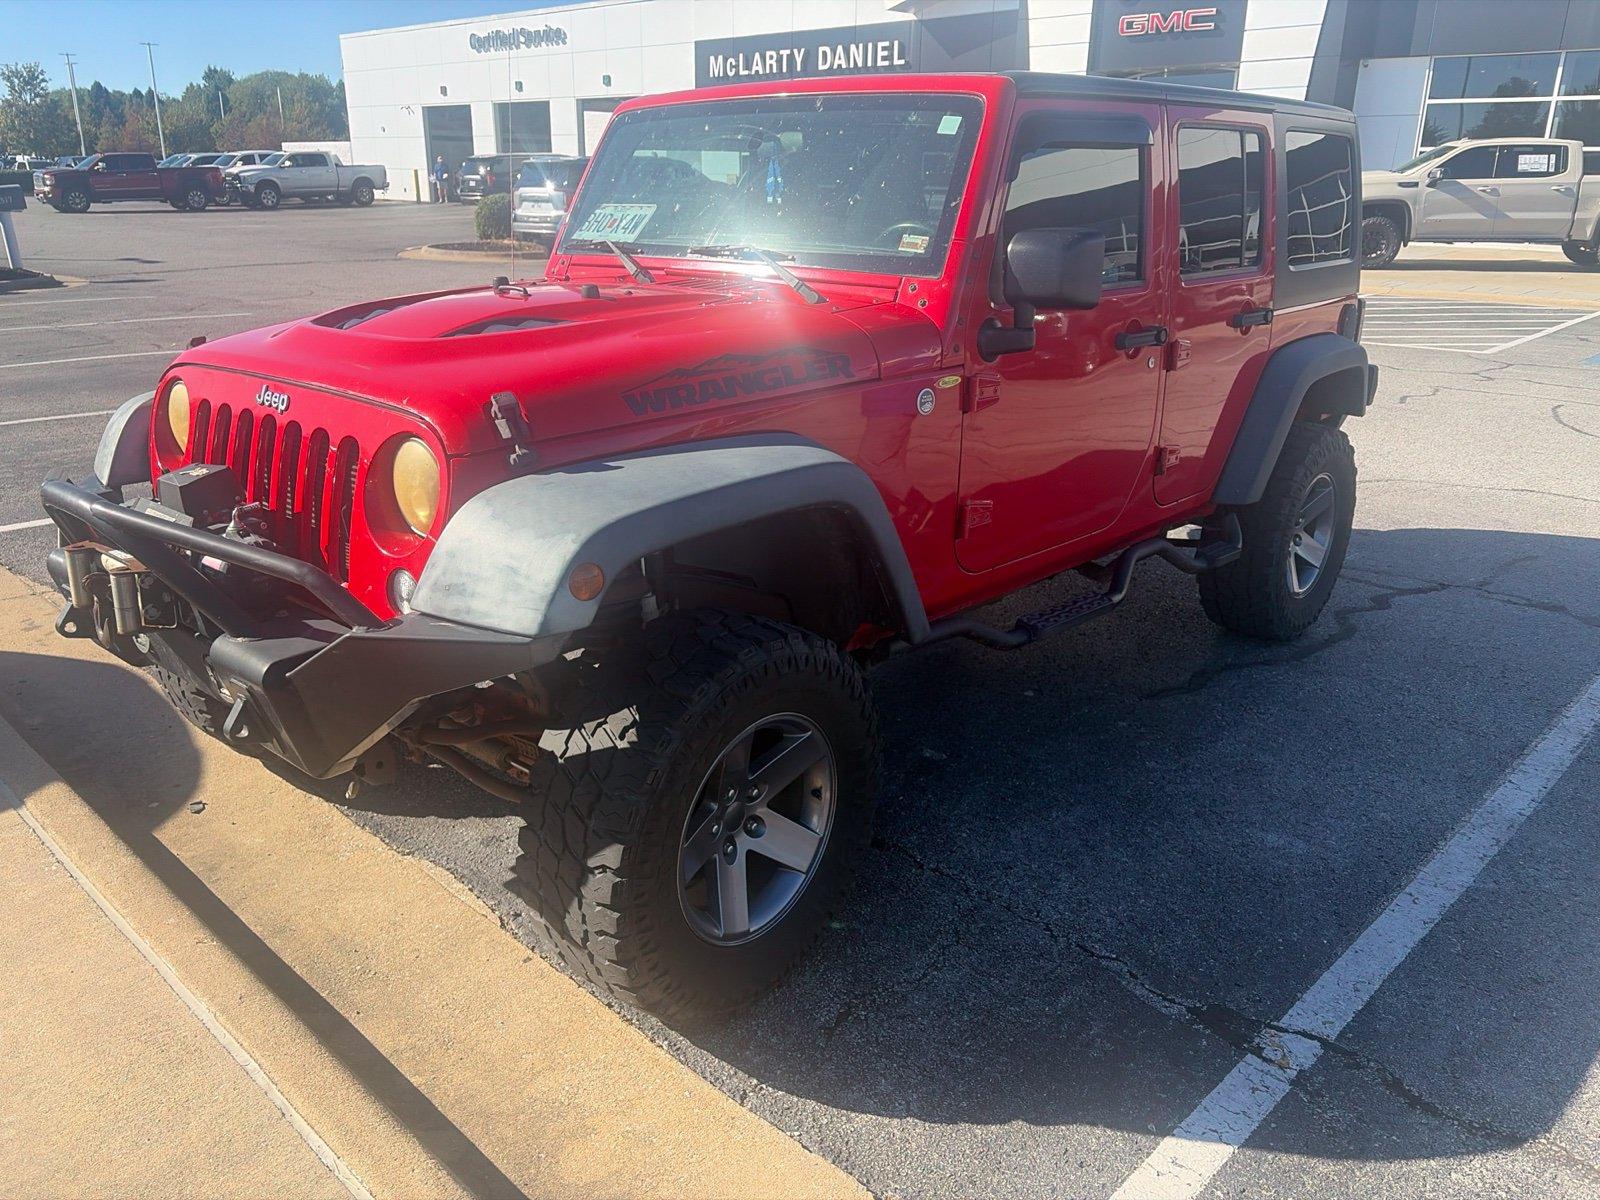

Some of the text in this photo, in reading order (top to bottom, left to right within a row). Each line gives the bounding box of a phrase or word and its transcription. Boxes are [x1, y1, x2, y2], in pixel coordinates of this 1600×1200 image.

[1119, 8, 1217, 36] GMC
[470, 24, 565, 51] Certified Service
[709, 40, 906, 78] McLARTY DANIEL
[256, 384, 289, 414] Jeep
[622, 355, 855, 416] WRANGLER
